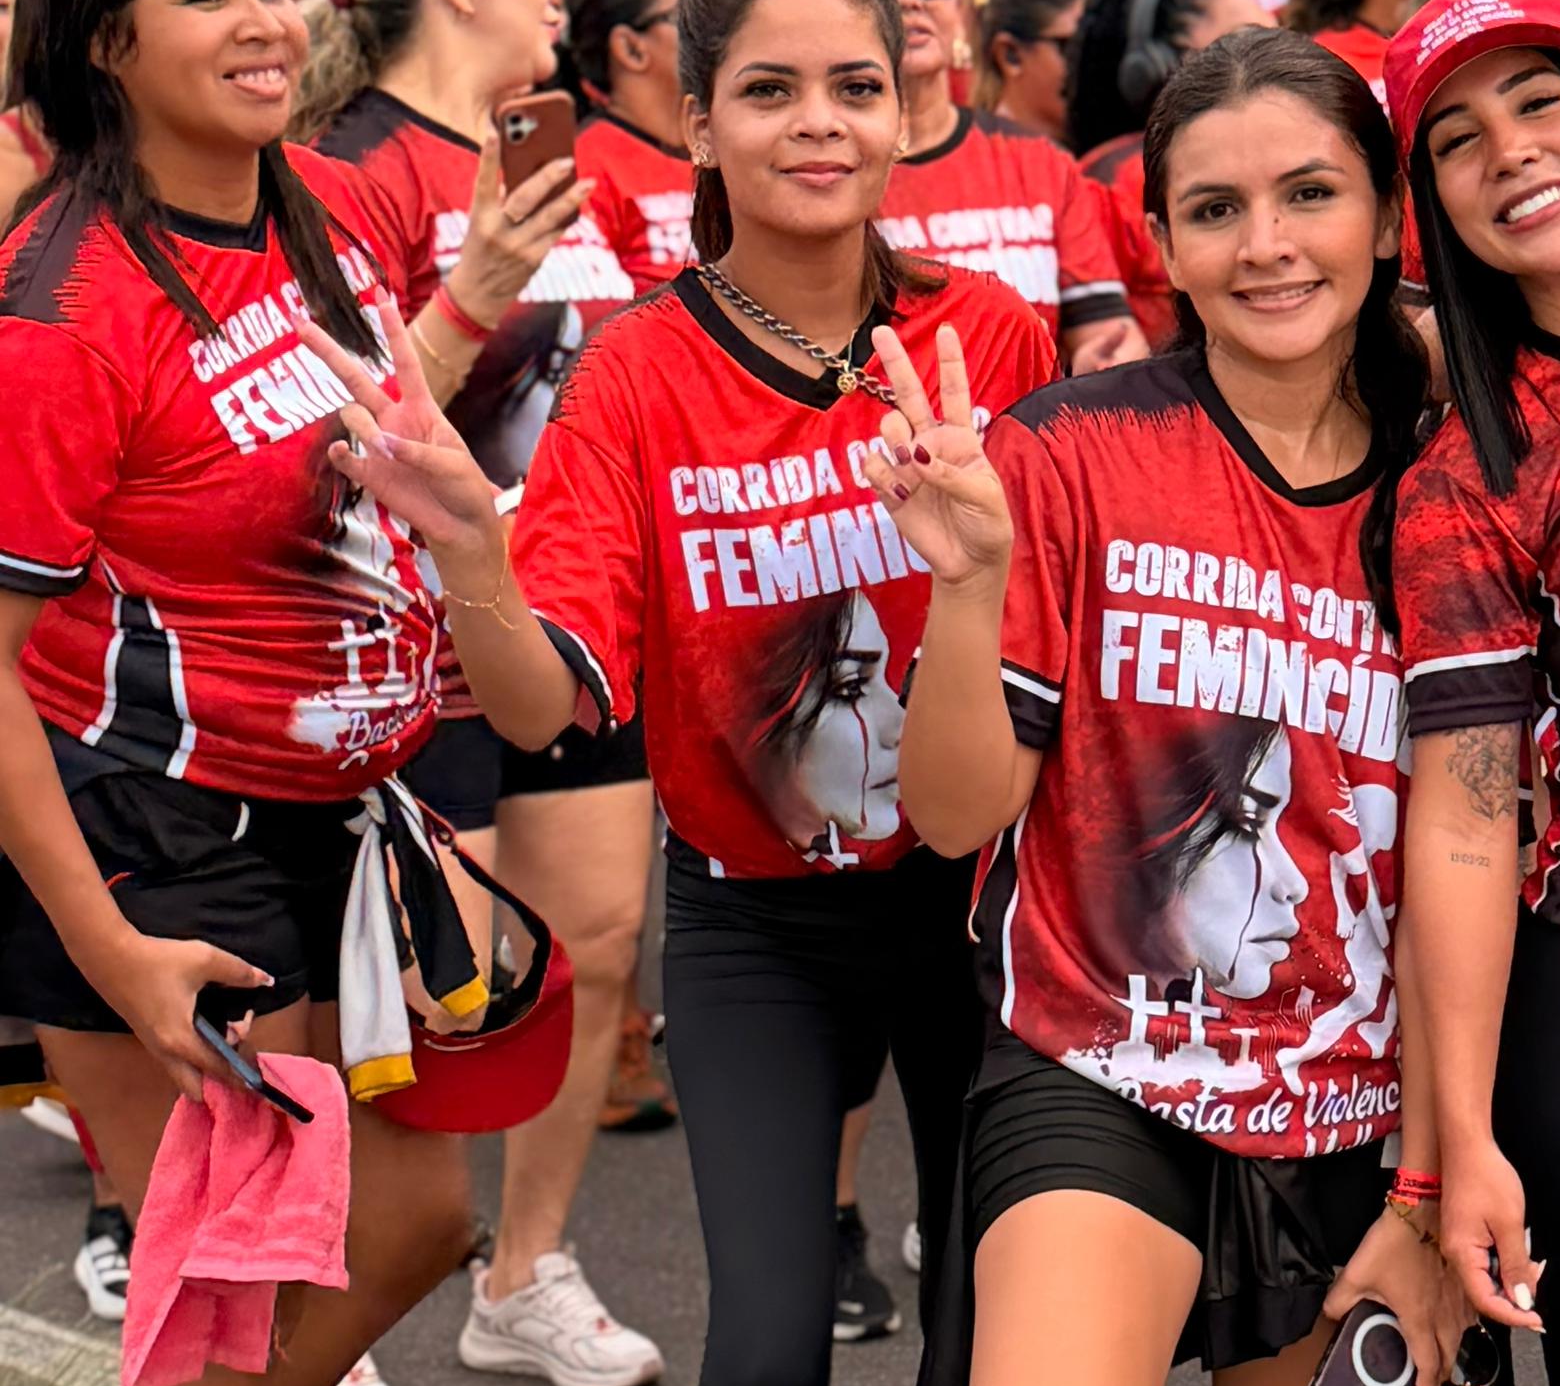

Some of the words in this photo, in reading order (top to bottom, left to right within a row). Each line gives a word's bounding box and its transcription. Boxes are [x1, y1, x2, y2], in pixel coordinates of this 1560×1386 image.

[669, 447, 844, 516] CORRIDA
[680, 501, 932, 613] FEMINI
[1106, 539, 1286, 623] CORRIDA
[1246, 1087, 1295, 1134] de
